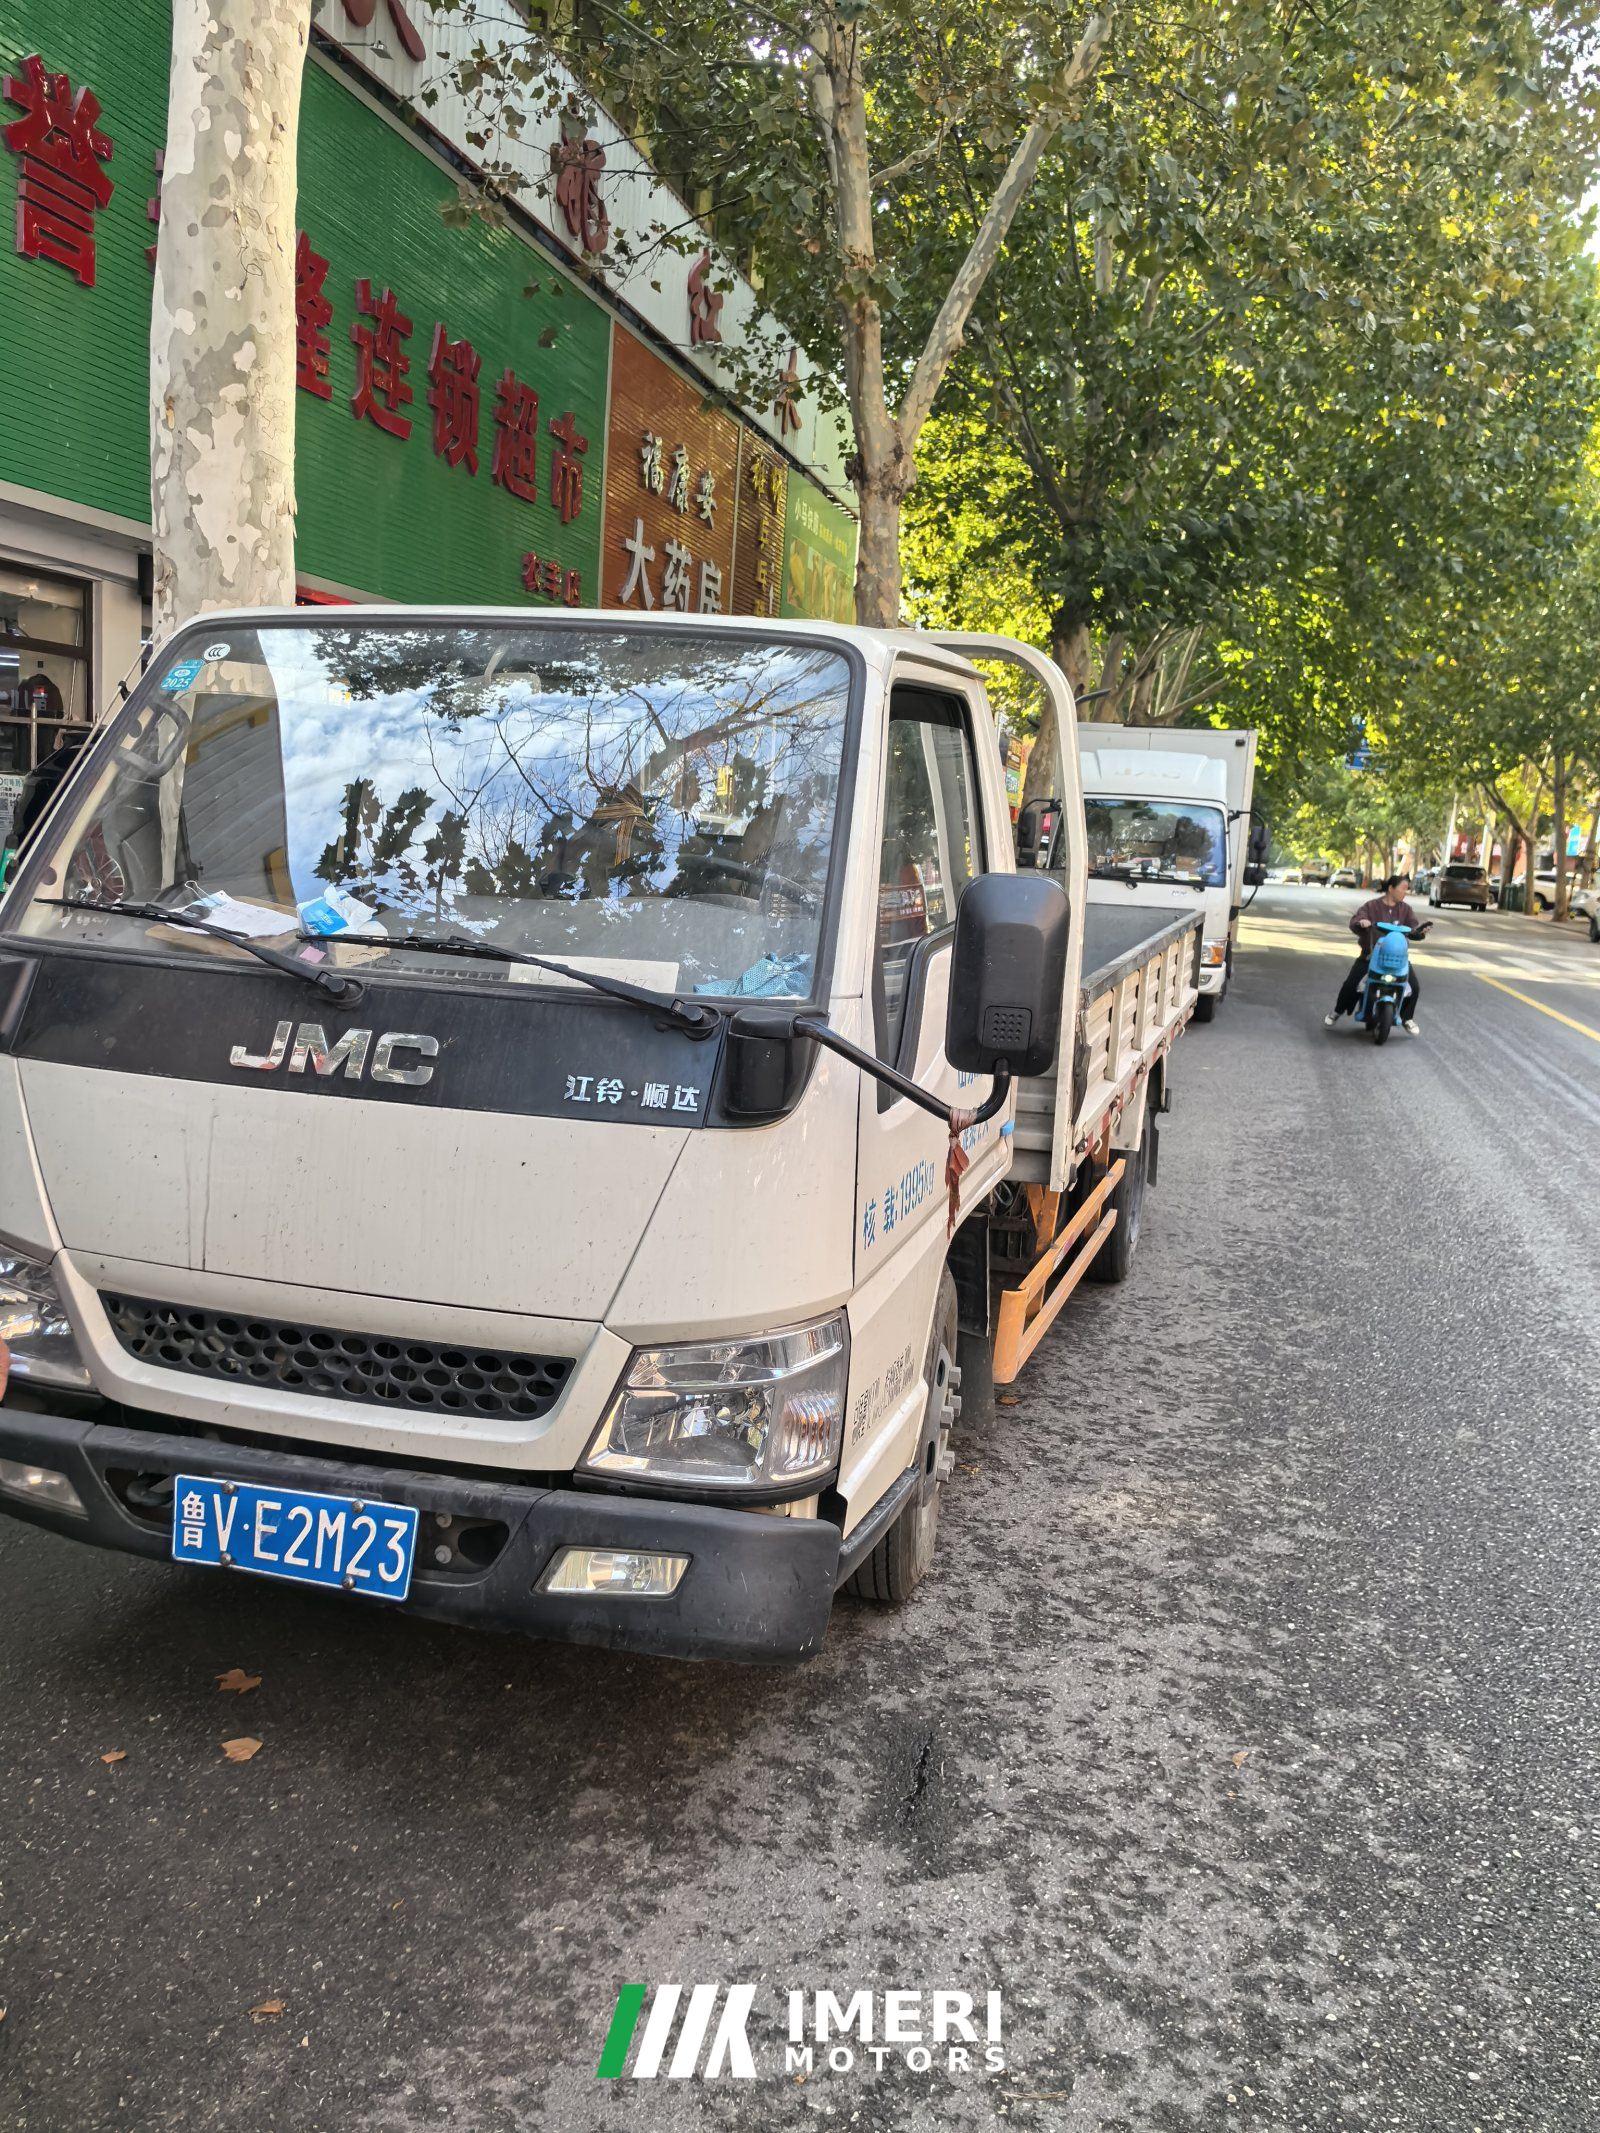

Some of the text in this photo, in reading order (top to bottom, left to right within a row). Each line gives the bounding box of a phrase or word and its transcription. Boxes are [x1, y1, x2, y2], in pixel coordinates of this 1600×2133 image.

[2, 53, 588, 524] 誉隆连锁超市
[619, 516, 722, 613] 大药房
[161, 678, 192, 689] 2025
[229, 1020, 440, 1086] JMC
[563, 1074, 700, 1112] 江铃·顺达
